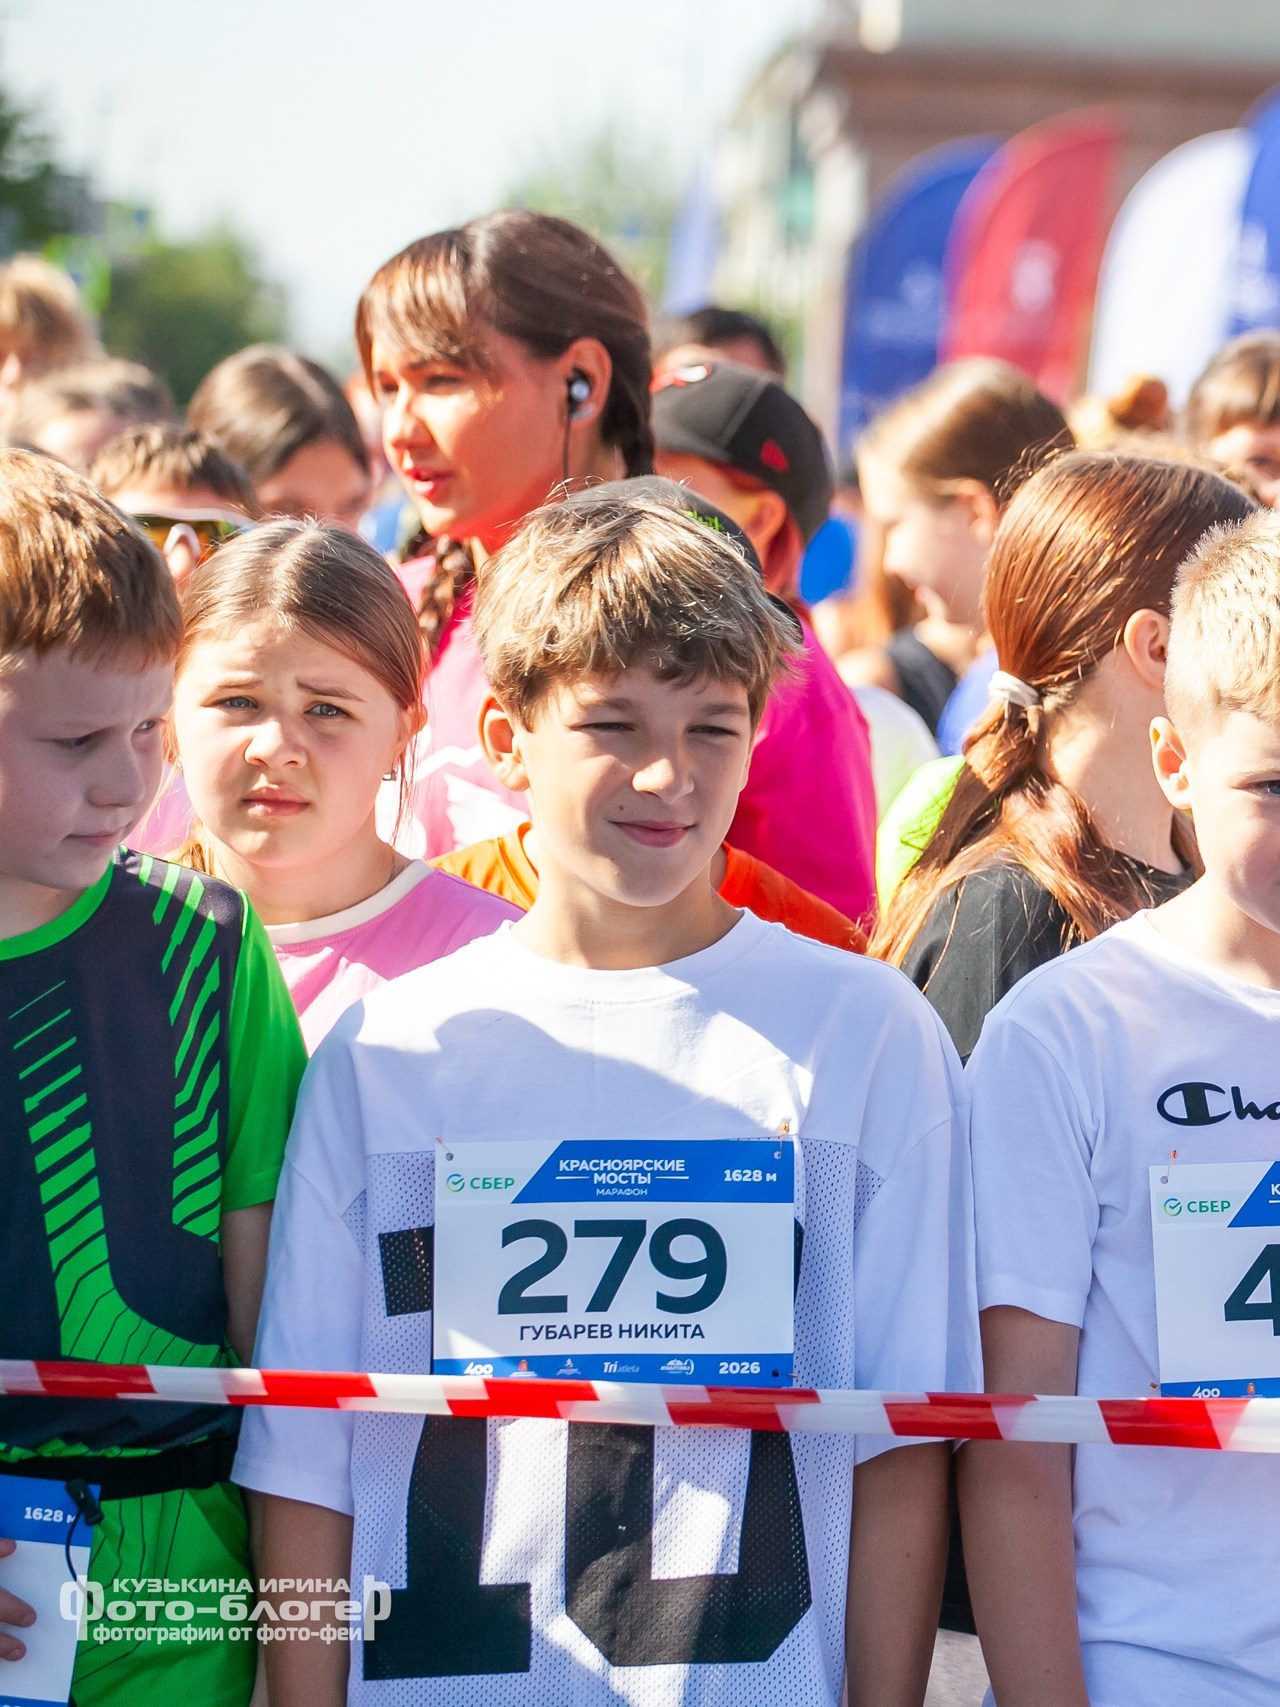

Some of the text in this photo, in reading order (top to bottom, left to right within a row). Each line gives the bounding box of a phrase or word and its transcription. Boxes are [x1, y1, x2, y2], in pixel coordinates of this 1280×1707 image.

[559, 1159, 685, 1172] КРАСНОЯРСКИЕ
[593, 1172, 651, 1185] МОСТЫ
[724, 1169, 763, 1182] 1628
[470, 1177, 515, 1190] СБЕР
[596, 1188, 648, 1196] МАРАФОН
[1187, 1200, 1231, 1213] СБЕР
[497, 1217, 728, 1315] 279
[519, 1323, 705, 1341] ГУБАРЕВ НИКИТА
[719, 1361, 761, 1374] 2026
[24, 1507, 64, 1522] 1628
